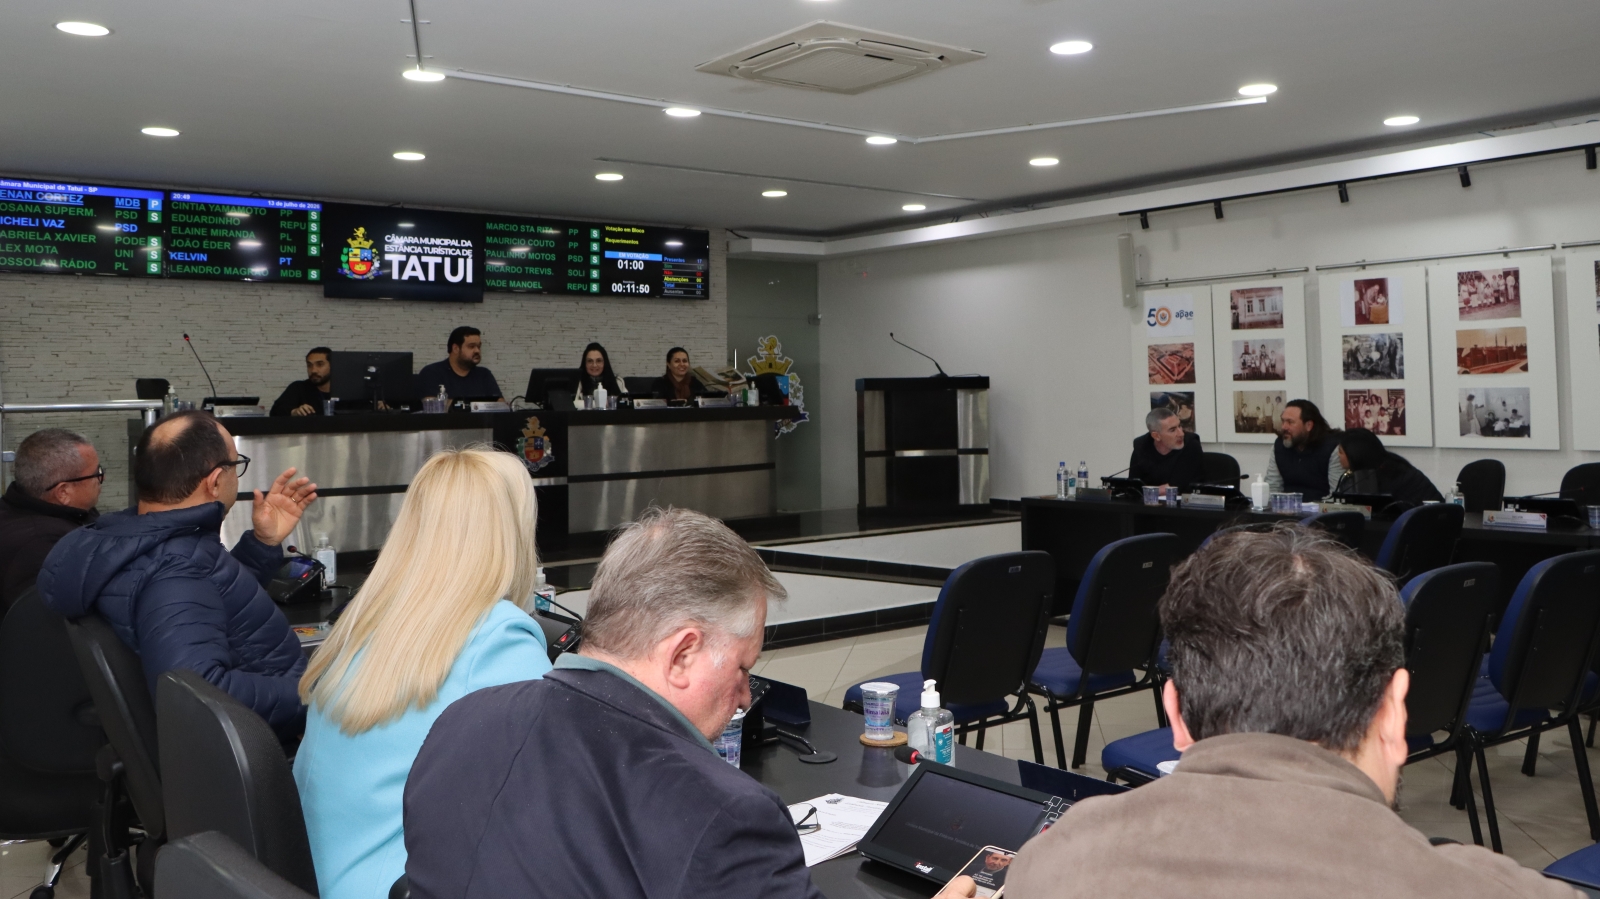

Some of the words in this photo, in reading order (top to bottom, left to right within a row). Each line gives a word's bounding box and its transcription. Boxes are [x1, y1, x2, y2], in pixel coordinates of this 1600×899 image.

[23, 182, 56, 190] Municipal
[36, 192, 84, 203] CORTEZ
[115, 197, 140, 207] MDB
[151, 200, 159, 208] P
[44, 206, 96, 217] SUPERM.
[115, 211, 138, 219] PSD
[151, 213, 158, 221] S
[209, 204, 267, 216] YAMAMOTO
[42, 219, 65, 228] VAZ
[115, 223, 138, 232] PSD
[171, 214, 241, 225] EDUARDINHO
[280, 221, 306, 230] REPU
[311, 223, 317, 231] S
[486, 223, 518, 231] MARCIO
[55, 233, 96, 243] XAVIER
[115, 237, 146, 245] PODE
[151, 238, 158, 246] S
[171, 226, 208, 236] ELAINE
[210, 229, 256, 239] MIRANDA
[280, 233, 292, 241] PL
[170, 238, 200, 248] JOÃO
[203, 239, 231, 250] ÉDER
[280, 245, 296, 253] UNI
[311, 246, 317, 254] S
[385, 234, 419, 244] CÂMARA
[420, 237, 461, 246] MUNICIPAL
[486, 237, 526, 246] MAURICIO
[528, 239, 555, 247] COUTO
[25, 245, 58, 254] MOTA
[115, 250, 134, 258] UNI
[151, 251, 158, 259] S
[385, 244, 422, 253] ESTÂNCIA
[423, 246, 461, 256] TURÍSTICA
[486, 250, 526, 259] PAULINHO
[528, 252, 556, 261] MOTOS
[60, 257, 96, 269] RÁDIO
[115, 262, 129, 270] PL
[151, 264, 158, 272] S
[169, 252, 208, 261] KELVIN
[279, 257, 292, 265] PT
[385, 253, 473, 283] TATUÍ
[525, 267, 554, 275] TREVIS.
[618, 260, 644, 270] 01:00
[170, 265, 221, 275] LEANDRO
[280, 270, 302, 278] MDB
[509, 280, 542, 288] MANOEL
[612, 283, 650, 293] 00:11:50
[1175, 310, 1193, 319] apae
